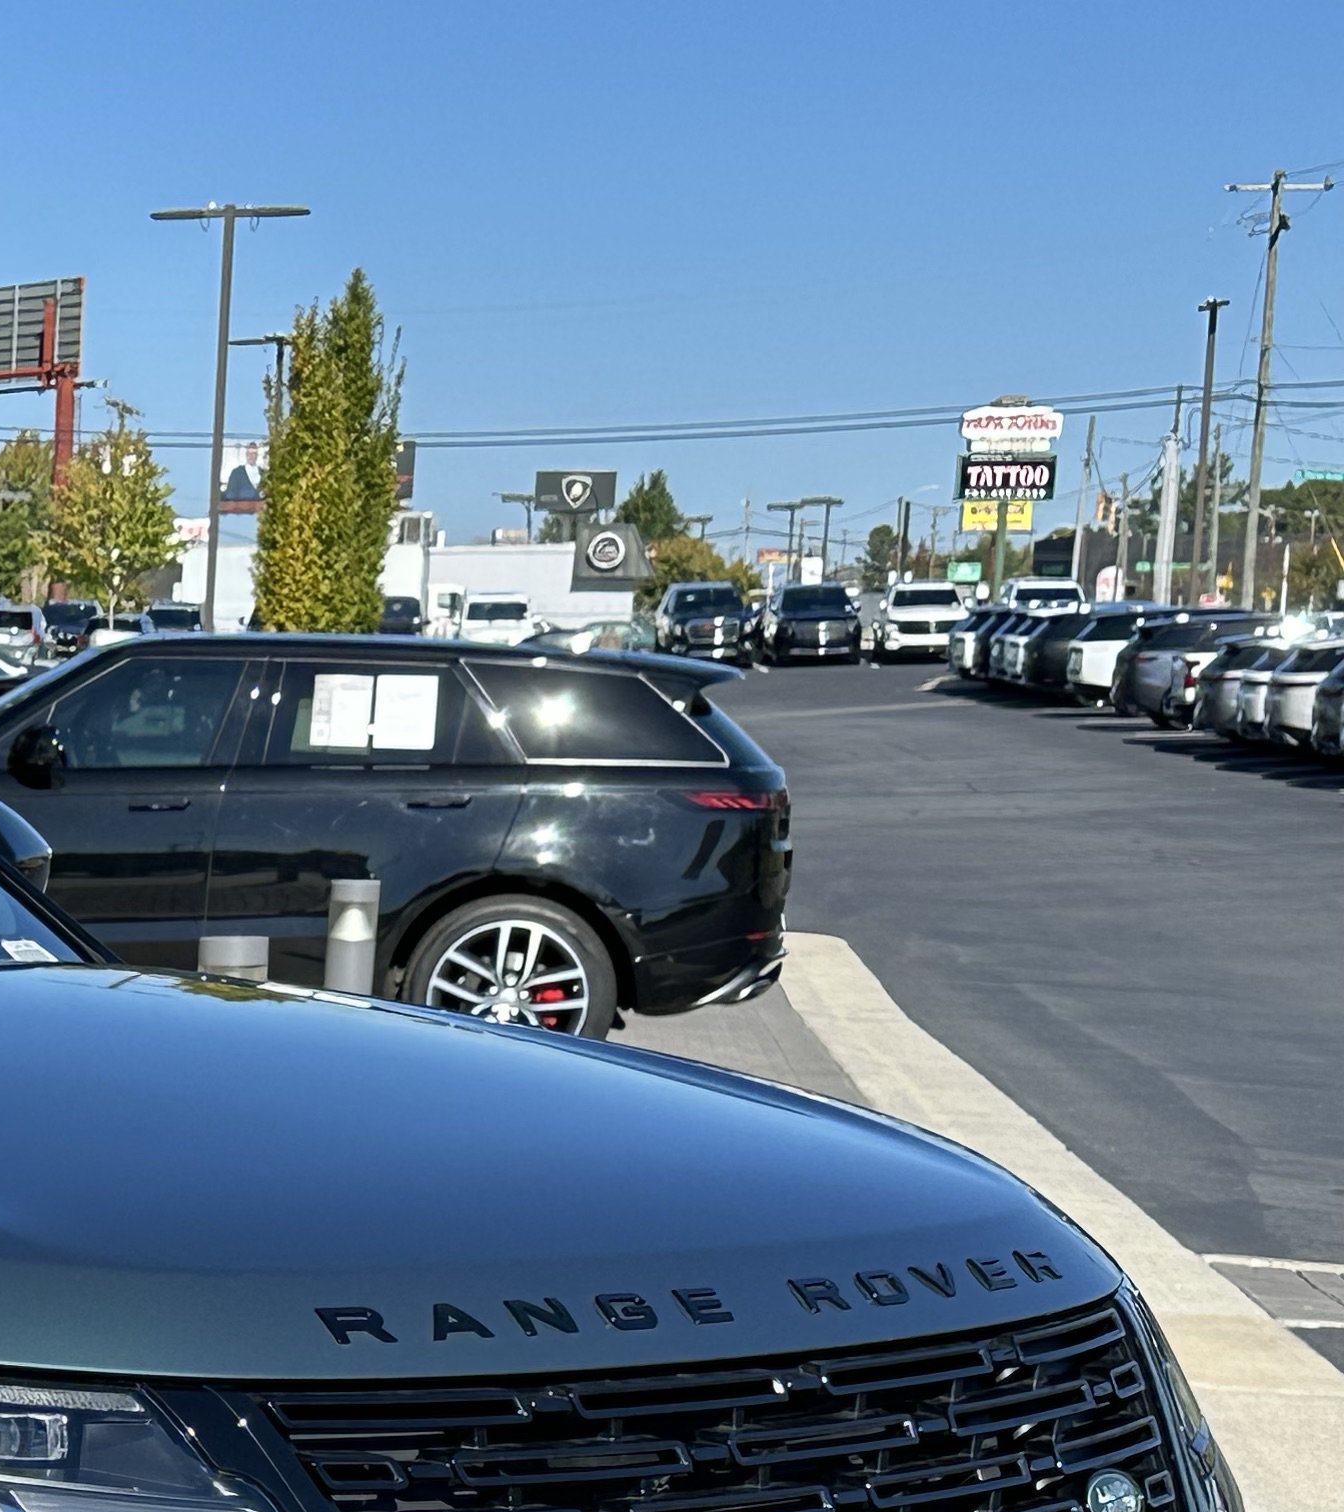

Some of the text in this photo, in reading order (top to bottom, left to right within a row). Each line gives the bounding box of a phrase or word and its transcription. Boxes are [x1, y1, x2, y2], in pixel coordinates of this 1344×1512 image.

[967, 465, 1049, 487] TATTOO
[314, 1249, 1064, 1345] RANGE ROVER
